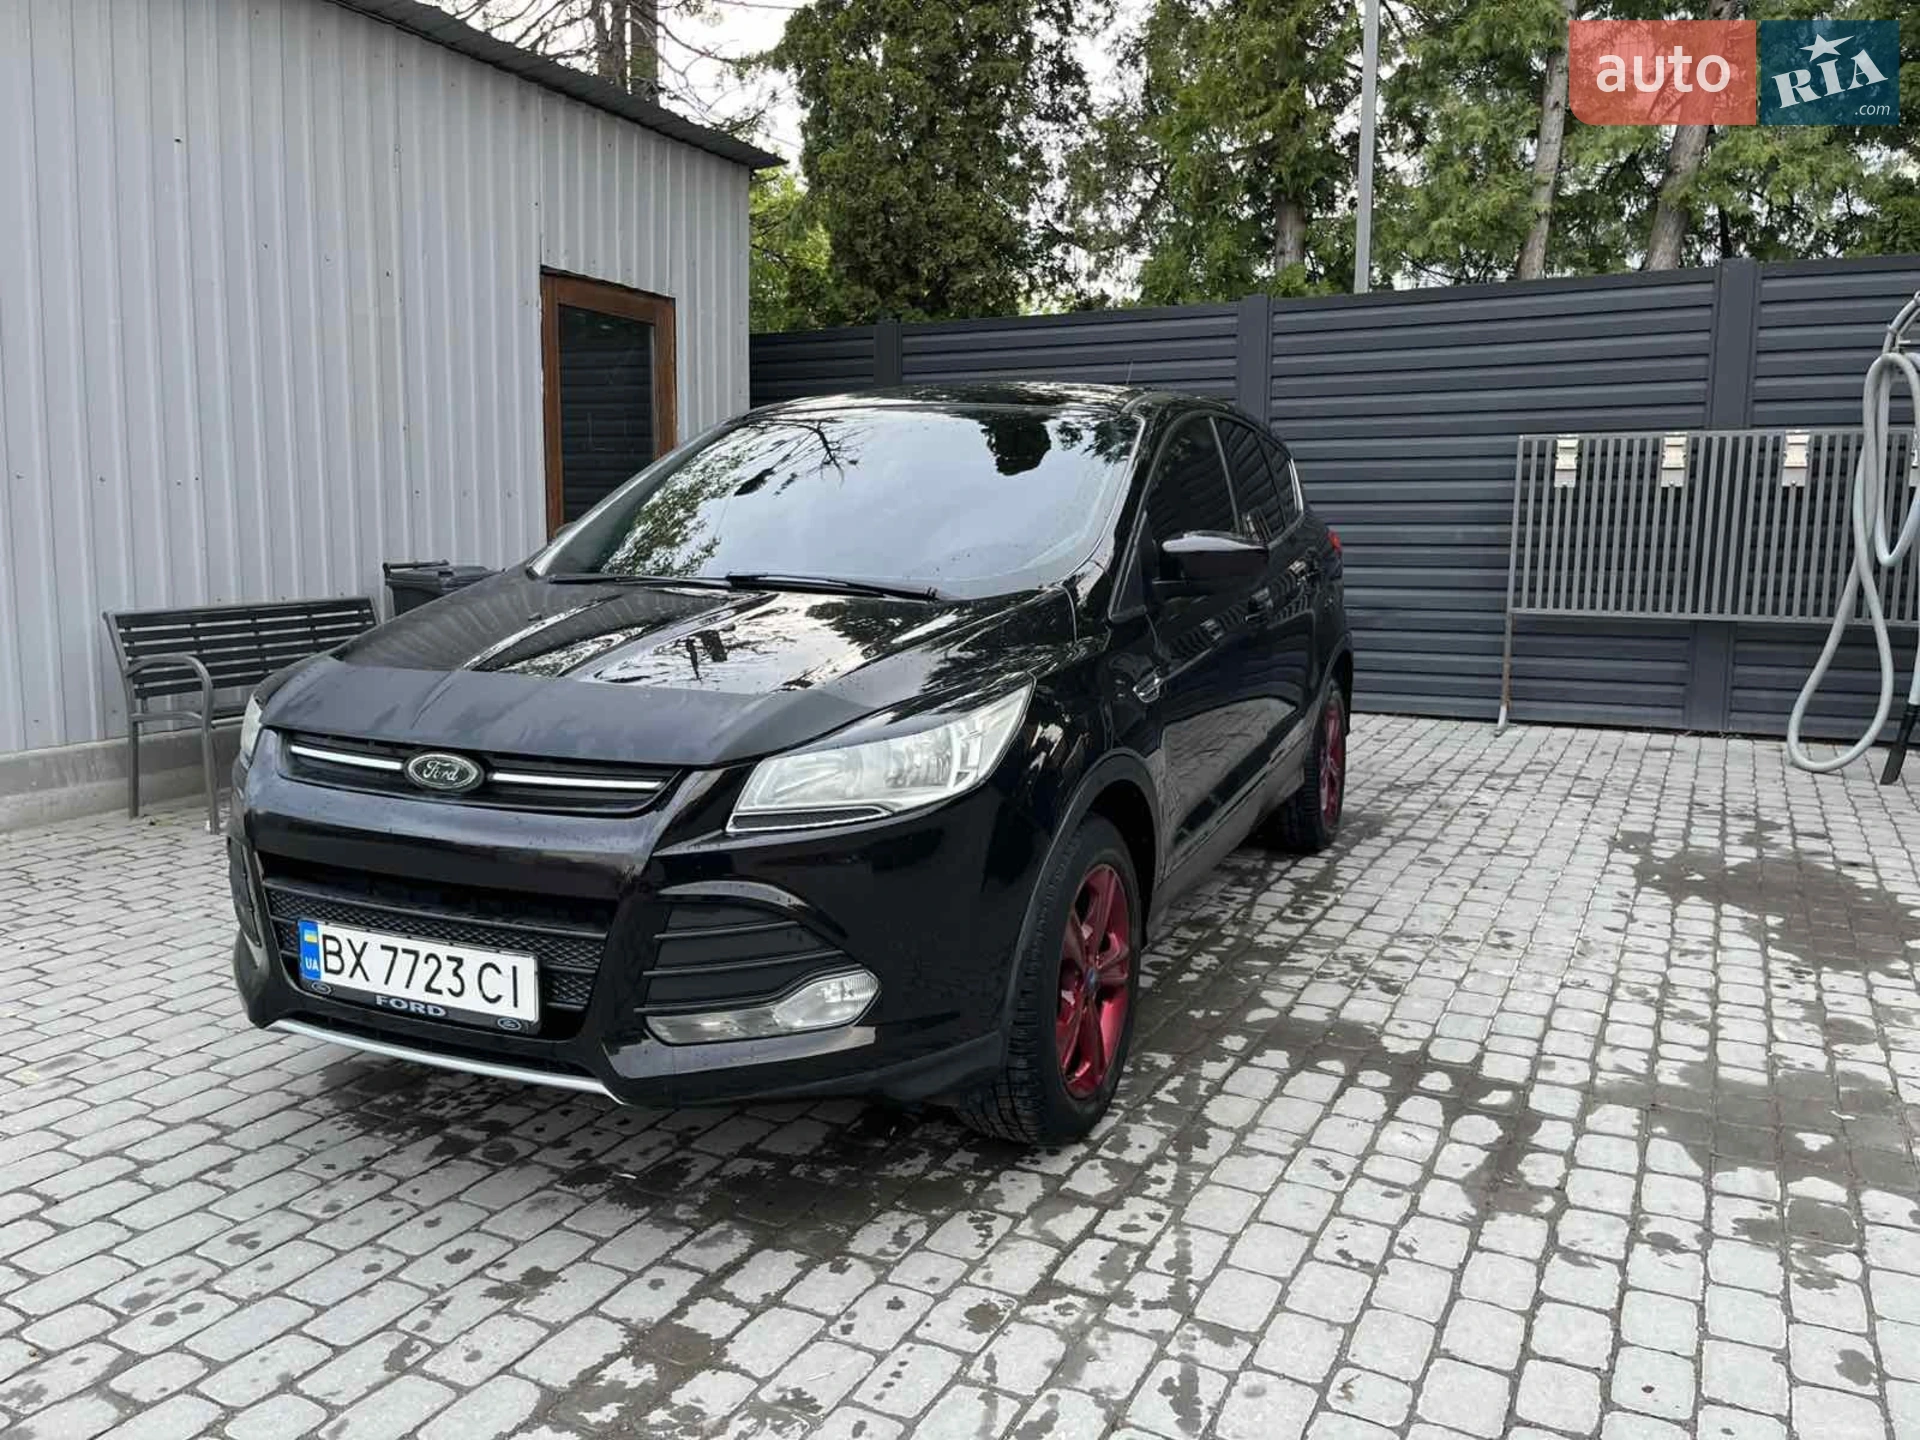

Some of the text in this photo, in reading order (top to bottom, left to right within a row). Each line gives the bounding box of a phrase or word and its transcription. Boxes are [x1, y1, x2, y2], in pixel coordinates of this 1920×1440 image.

[423, 760, 460, 781] Ford
[305, 957, 319, 971] UA
[322, 934, 518, 1008] BX 7723 CI
[376, 995, 447, 1017] FORD
